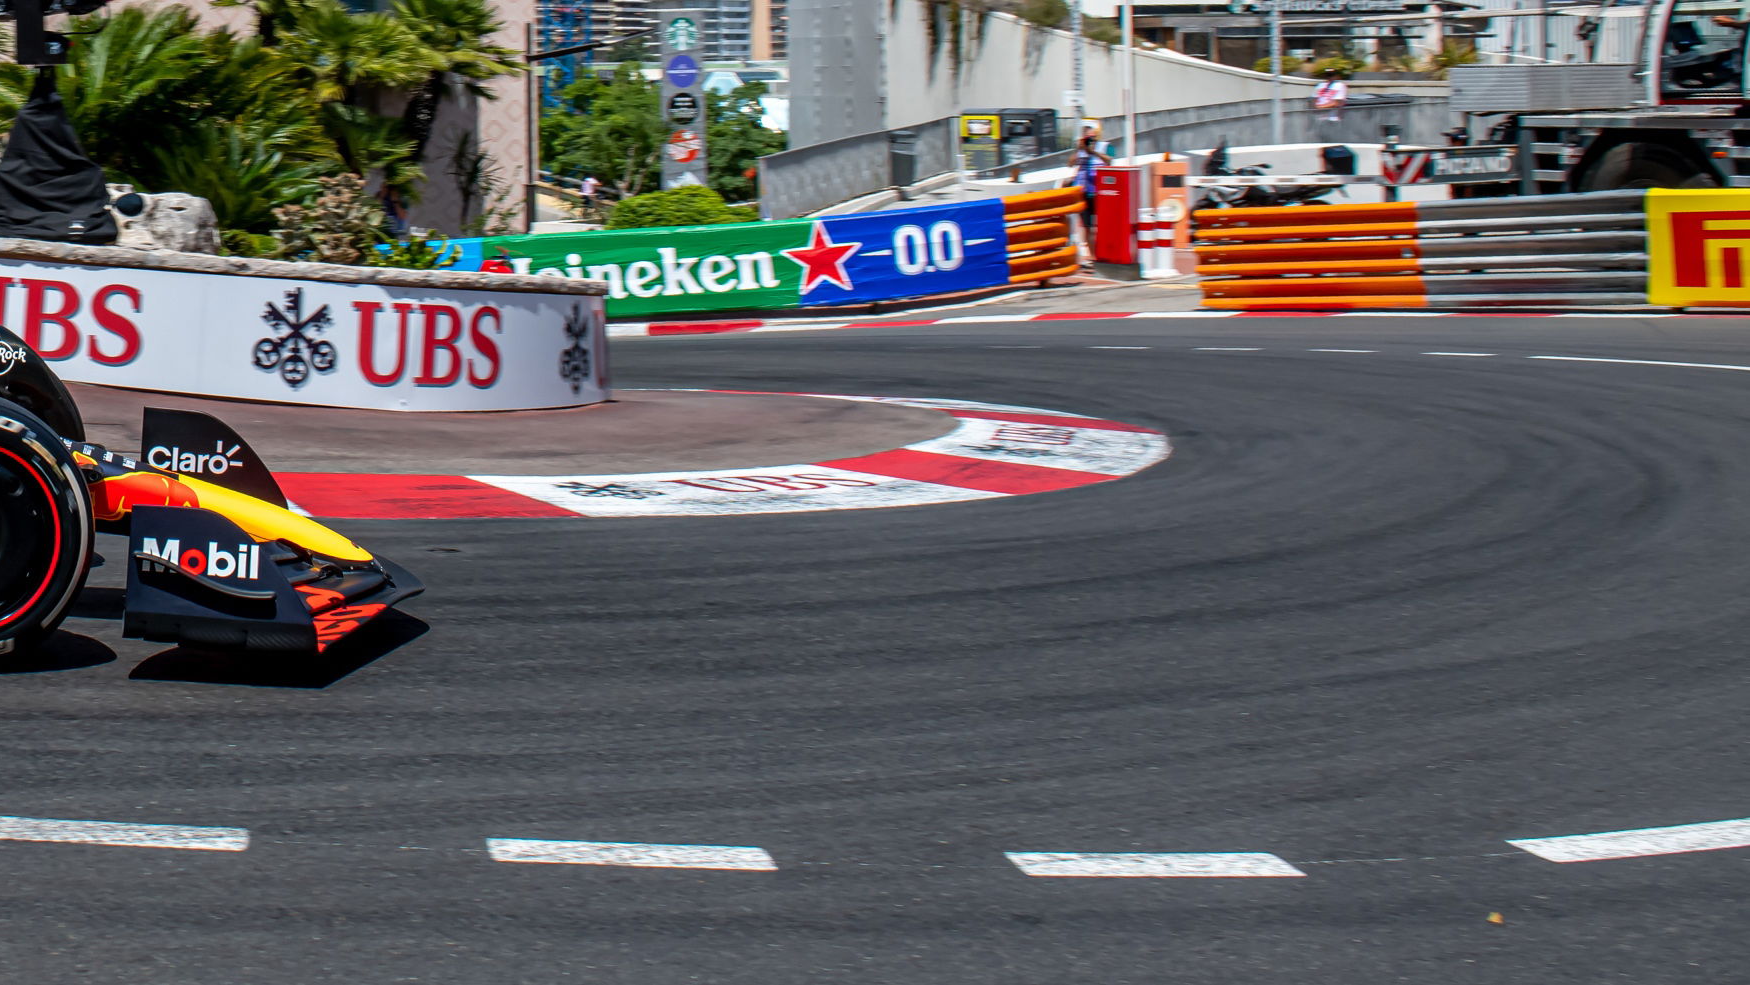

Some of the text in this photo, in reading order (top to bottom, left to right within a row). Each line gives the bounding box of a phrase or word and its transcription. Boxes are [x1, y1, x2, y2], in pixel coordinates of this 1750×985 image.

[892, 221, 963, 275] 0.0
[353, 300, 503, 389] UBS
[147, 444, 229, 475] Claro
[657, 472, 880, 494] UBS
[140, 536, 261, 581] Mobil
